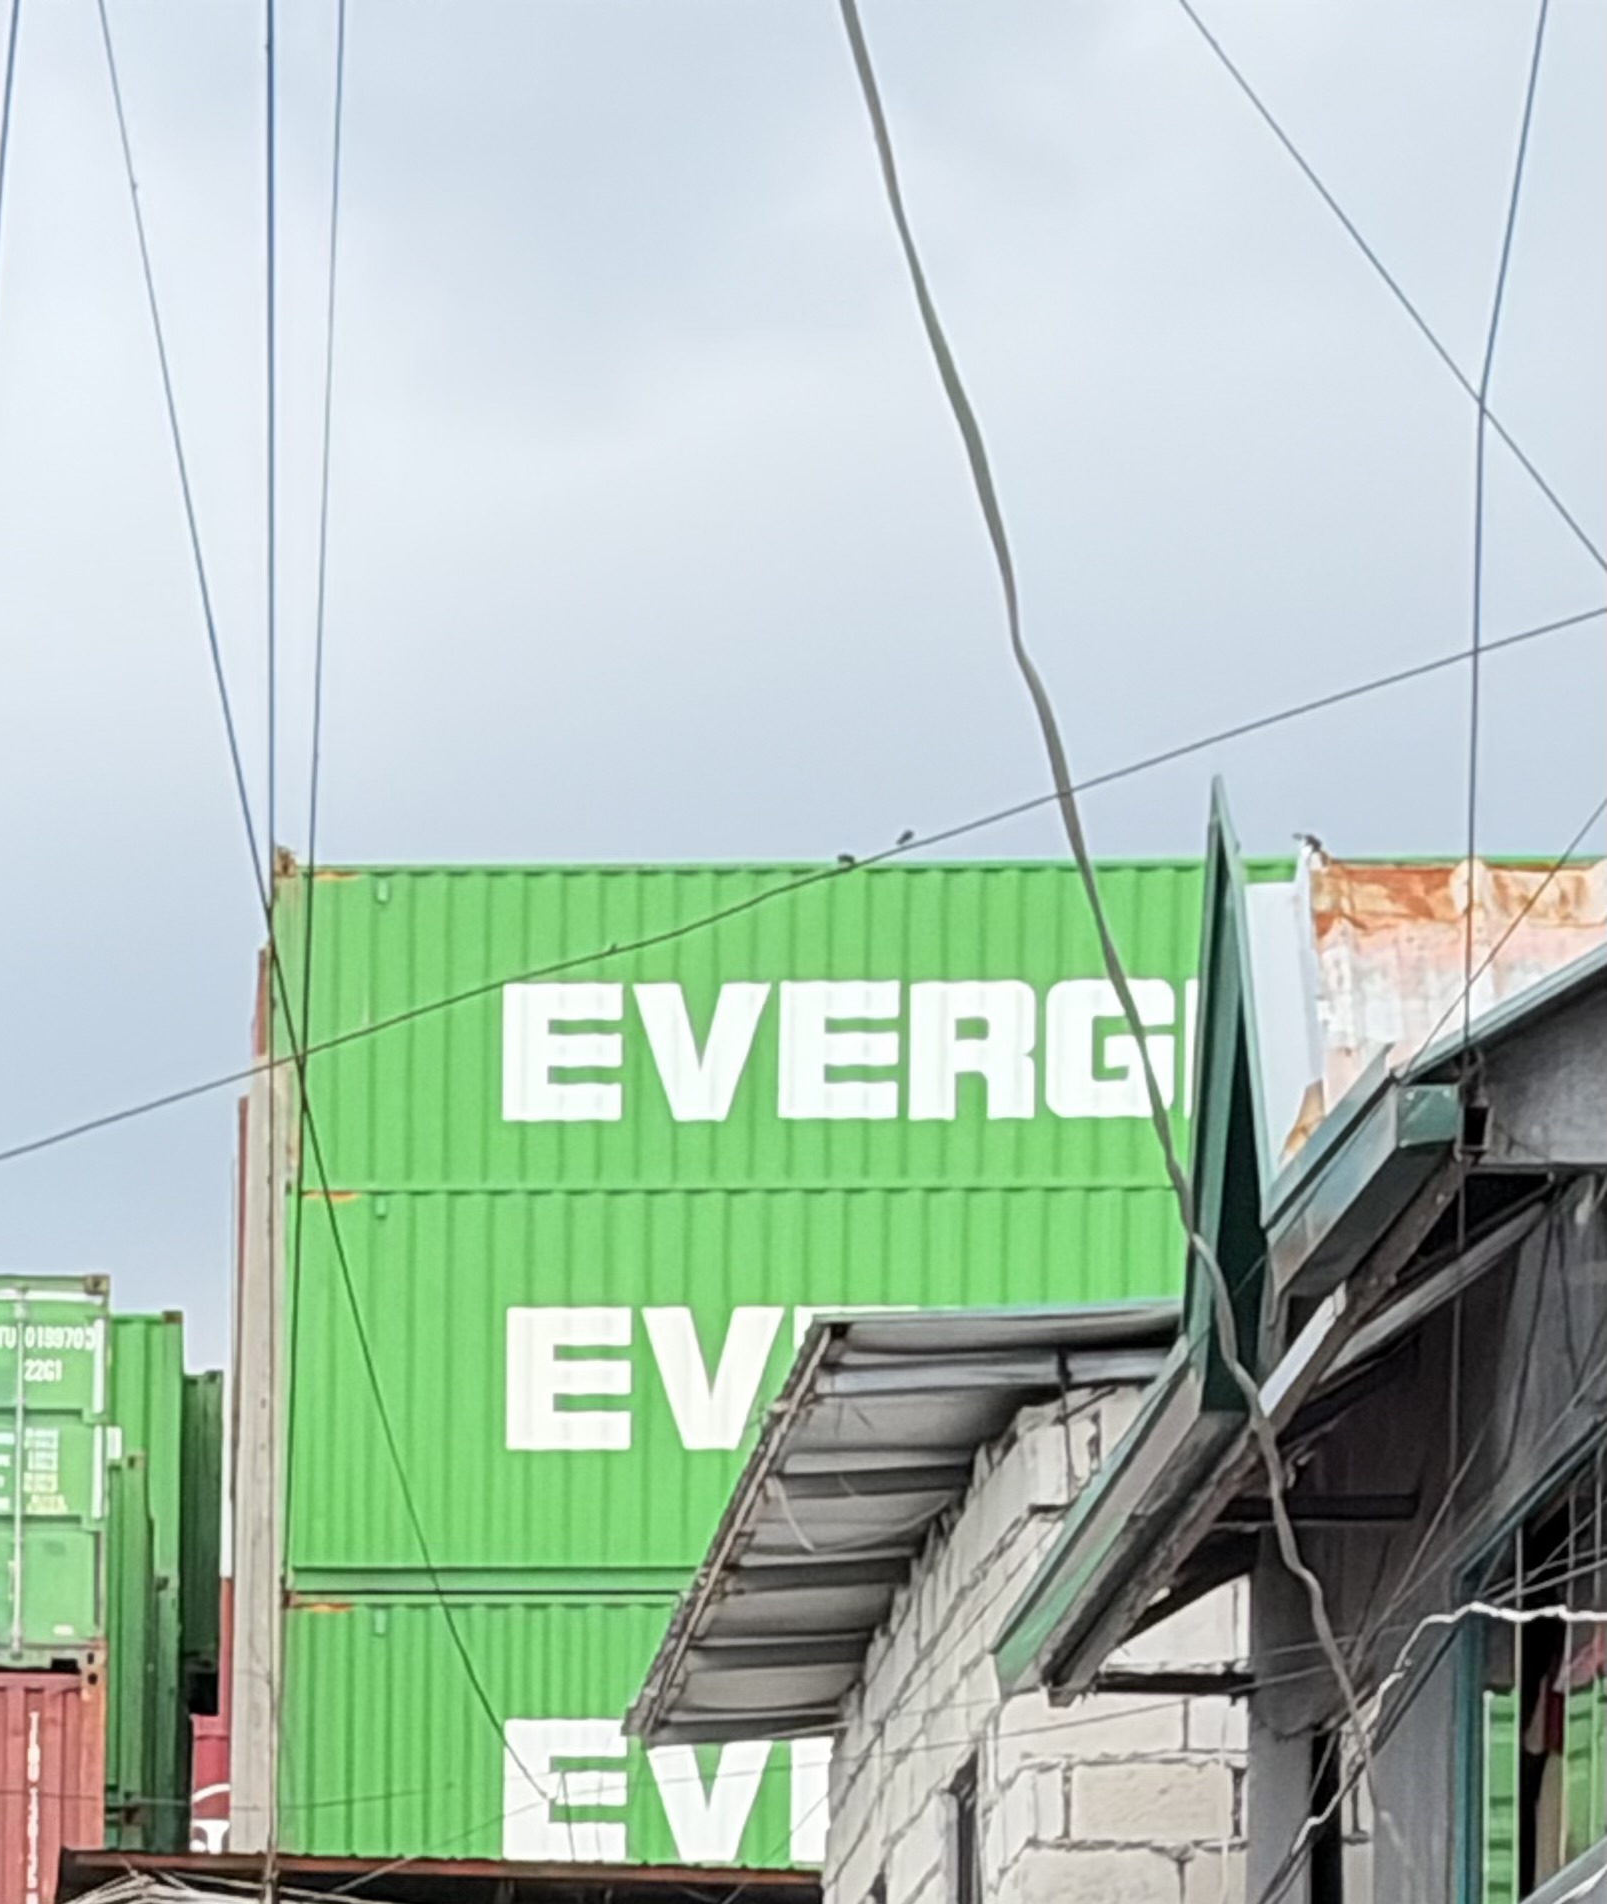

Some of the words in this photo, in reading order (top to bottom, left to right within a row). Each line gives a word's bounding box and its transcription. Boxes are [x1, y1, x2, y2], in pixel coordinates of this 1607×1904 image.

[501, 978, 1198, 1123] EVERG
[23, 1358, 63, 1382] 22G1
[504, 1304, 919, 1451] EV
[501, 1717, 831, 1863] EV
